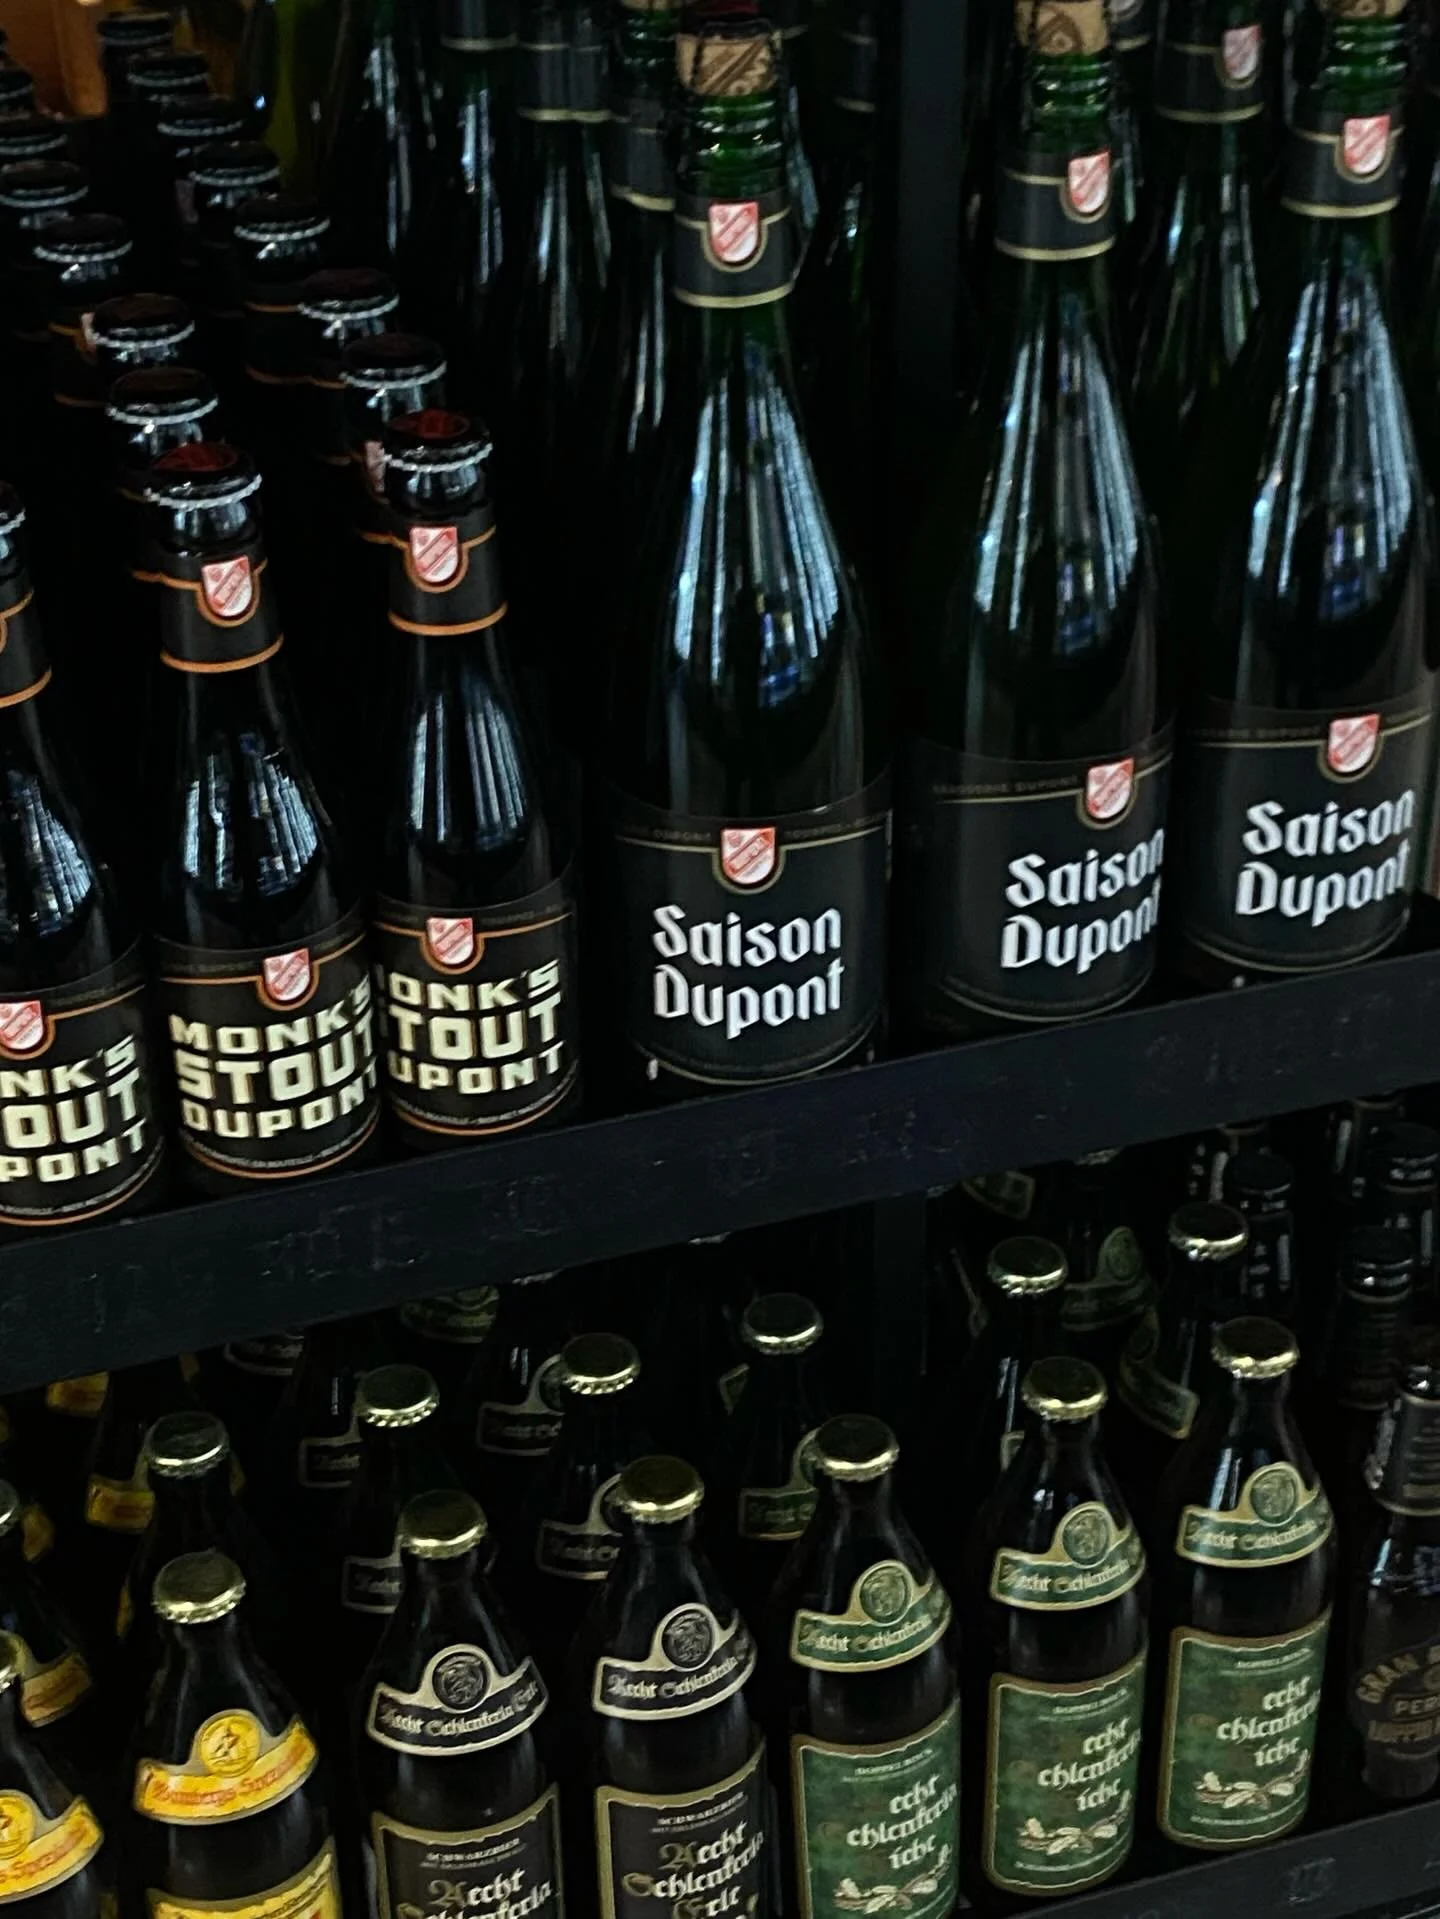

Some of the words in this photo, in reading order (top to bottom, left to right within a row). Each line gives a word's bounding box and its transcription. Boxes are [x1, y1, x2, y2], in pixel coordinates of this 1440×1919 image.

[1241, 789, 1416, 857] Saison
[1005, 827, 1166, 909] Saison
[1235, 838, 1412, 928] Dupont
[651, 903, 842, 968] Saison
[1000, 873, 1163, 976] Dupont
[168, 970, 371, 1054] MONK'S
[375, 958, 560, 1012] ONK'S
[380, 991, 562, 1061] TOUT
[652, 956, 846, 1040] Dupont
[175, 1006, 373, 1105] STOUT
[181, 1055, 378, 1139] DUPONT
[656, 1820, 748, 1871] Aecht
[427, 1867, 526, 1908] Aecht
